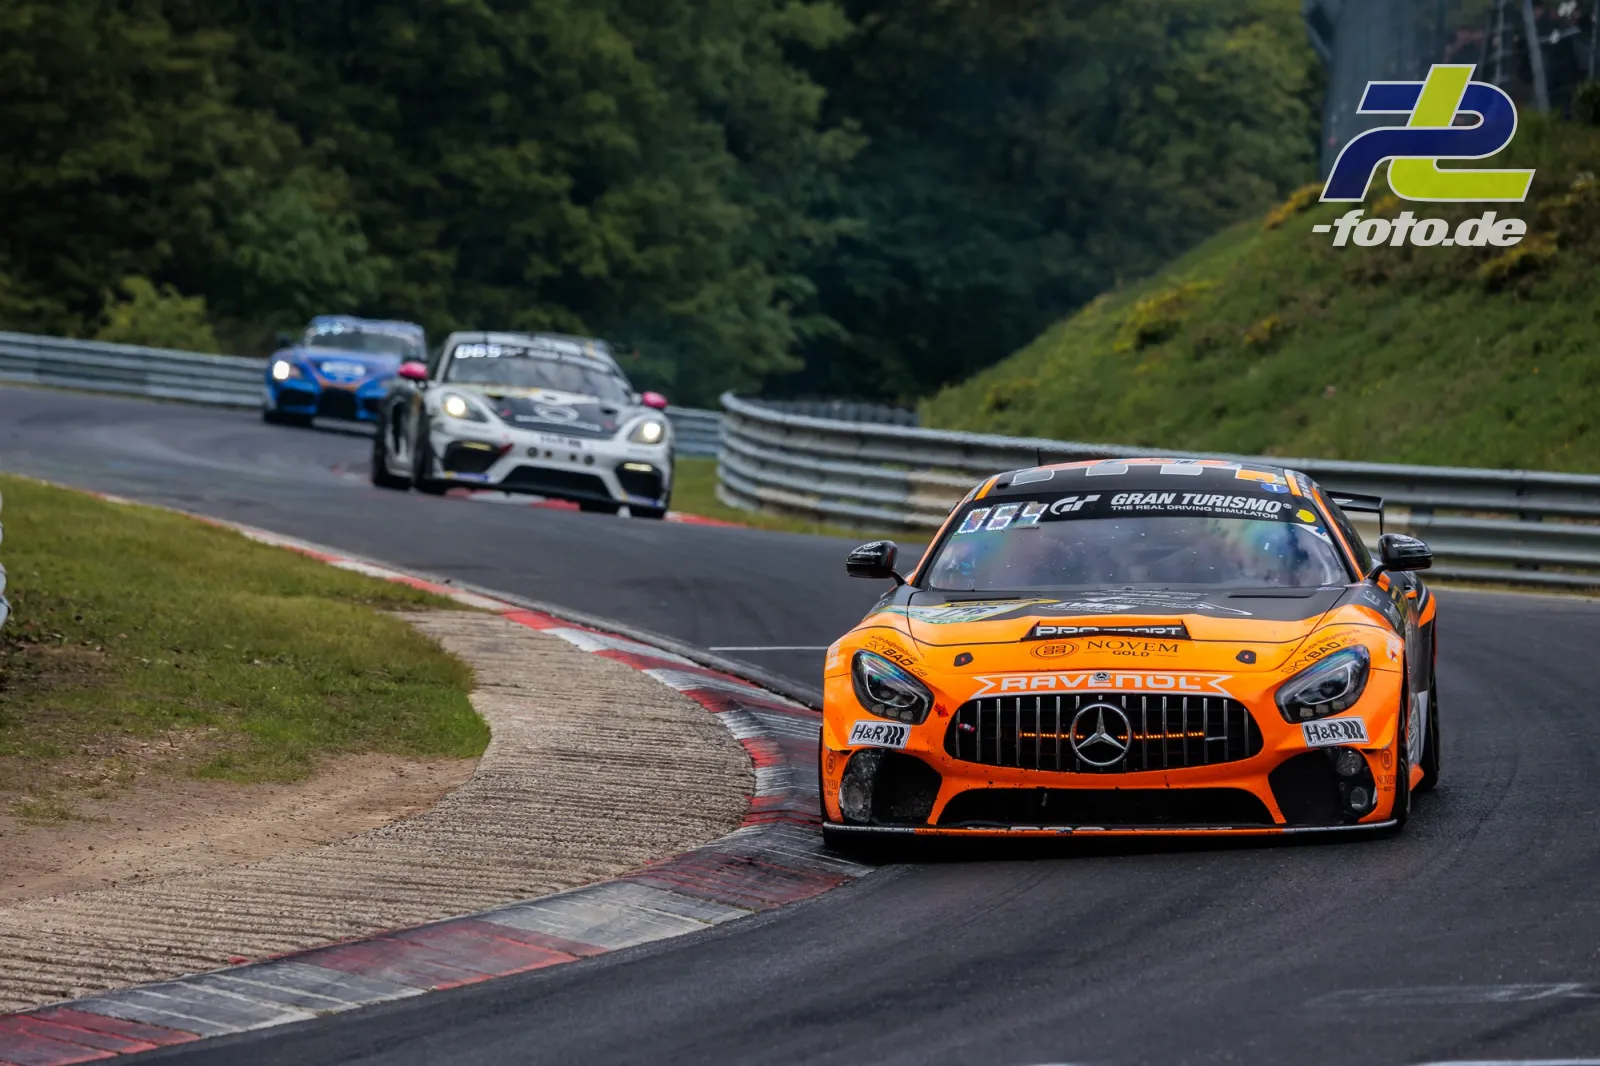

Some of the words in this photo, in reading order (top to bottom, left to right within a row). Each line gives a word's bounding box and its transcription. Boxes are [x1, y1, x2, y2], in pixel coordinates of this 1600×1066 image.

[1110, 492, 1177, 505] GRAN
[1181, 493, 1282, 513] TURISMO
[957, 502, 1049, 534] 064
[1167, 504, 1213, 512] DRIVING
[1214, 507, 1279, 520] SIMULATOR
[1087, 640, 1179, 653] NOVEM
[1000, 674, 1201, 691] RAVENOL
[1304, 722, 1342, 742] H&R
